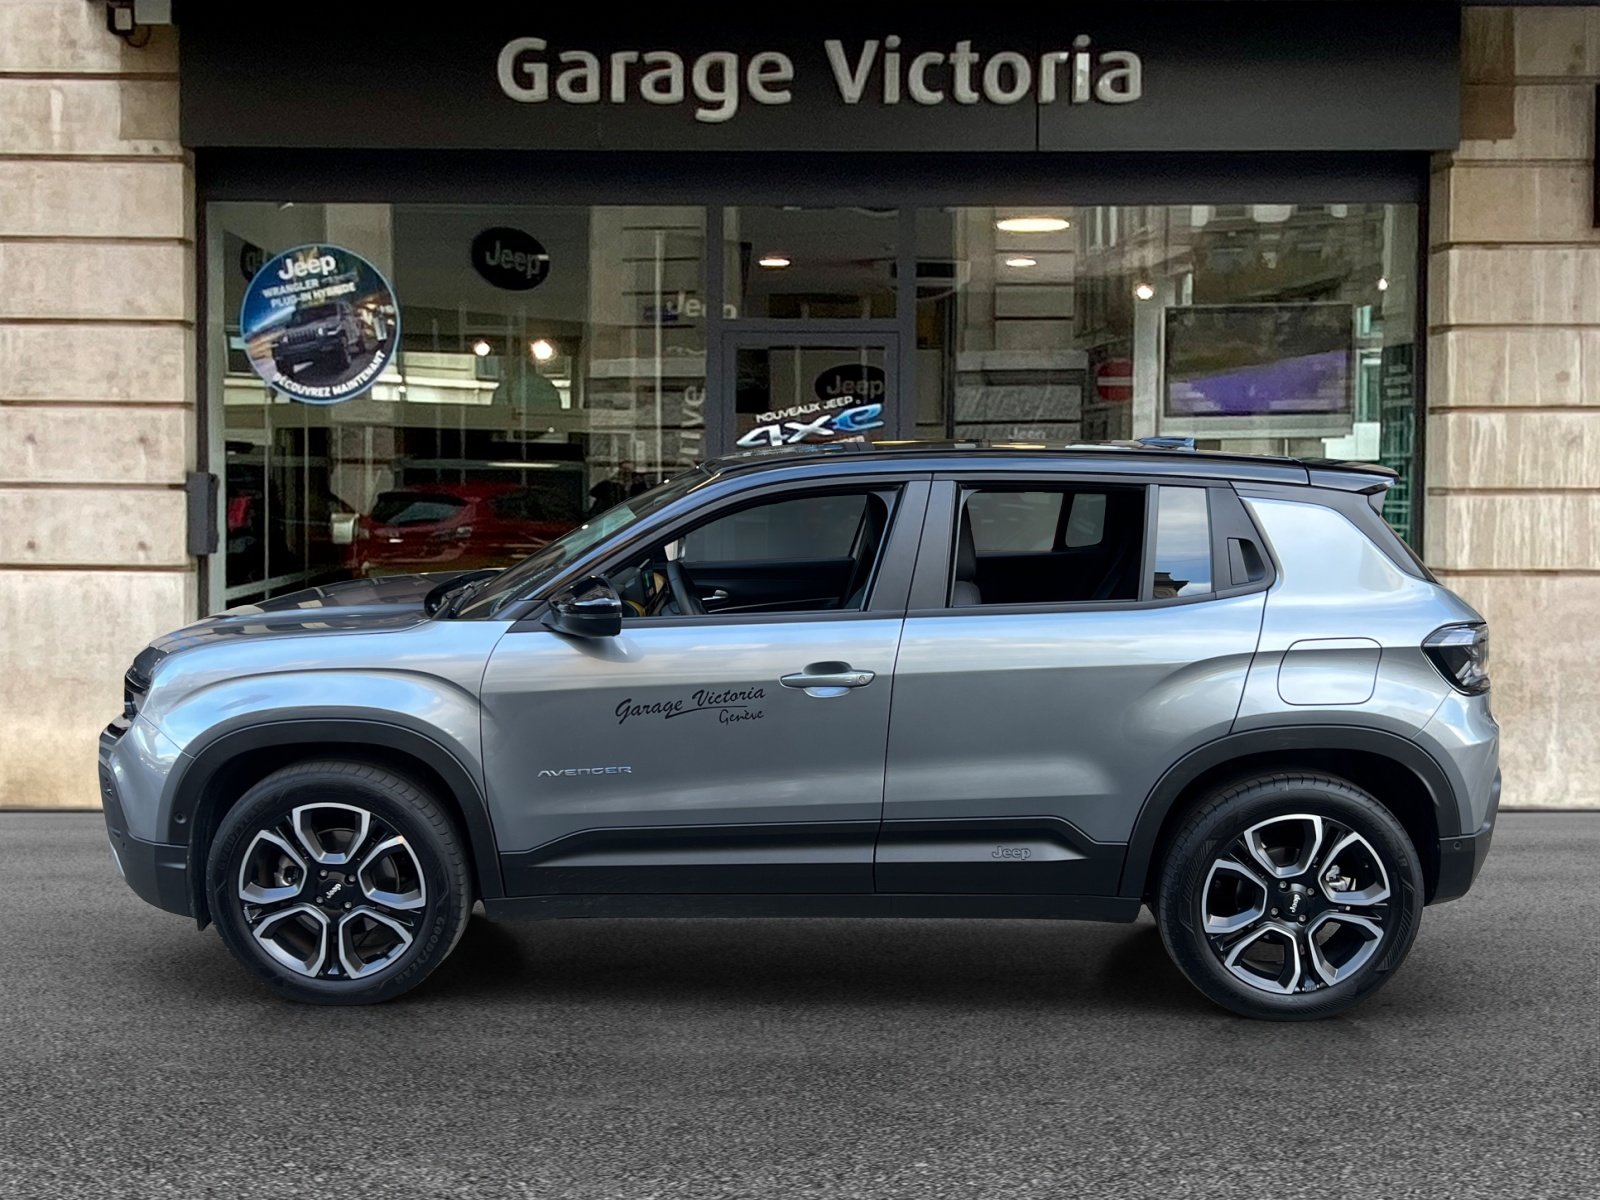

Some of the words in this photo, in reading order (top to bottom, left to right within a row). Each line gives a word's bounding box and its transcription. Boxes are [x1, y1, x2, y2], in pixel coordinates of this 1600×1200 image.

[497, 37, 794, 123] Garage
[824, 34, 1142, 104] Victoria
[278, 254, 336, 280] Jeep
[485, 240, 542, 279] Jeep
[262, 278, 320, 298] WRANGLER
[270, 290, 312, 308] PLUG-IN
[331, 349, 386, 396] MAINTENANT
[827, 374, 884, 399] Jeep
[756, 402, 821, 423] NOUVEAUX
[823, 395, 854, 412] JEEP
[615, 697, 683, 725] Garage
[691, 686, 766, 708] Victoria
[719, 708, 765, 726] Genève
[537, 765, 632, 778] AVENGER
[991, 845, 1032, 861] Jeep
[1288, 894, 1301, 914] Jeep
